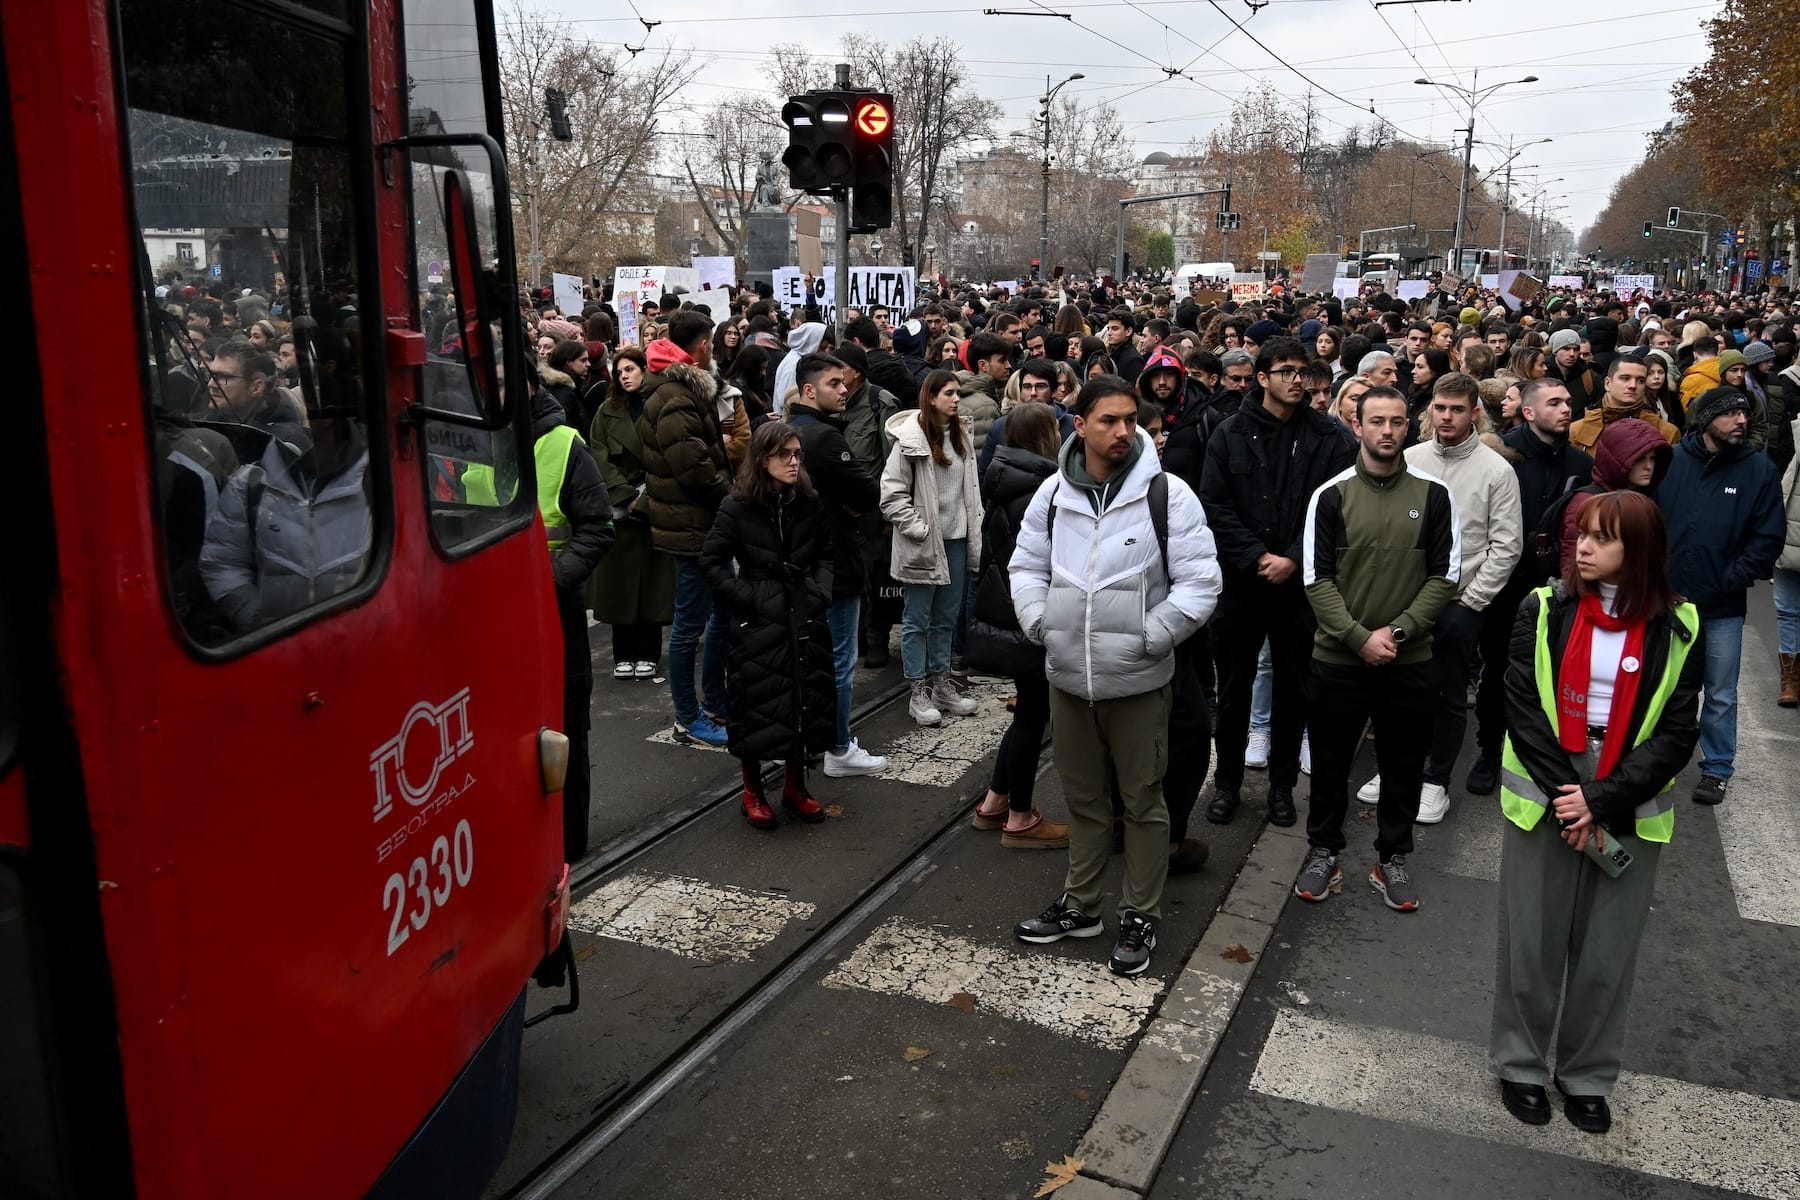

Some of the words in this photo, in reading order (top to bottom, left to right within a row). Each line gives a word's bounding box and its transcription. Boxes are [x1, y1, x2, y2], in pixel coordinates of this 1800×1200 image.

[866, 272, 905, 306] ШТА
[1772, 260, 1780, 270] P
[369, 686, 475, 823] ГСП
[376, 772, 477, 863] БЕОГРАД
[382, 818, 474, 958] 2330
